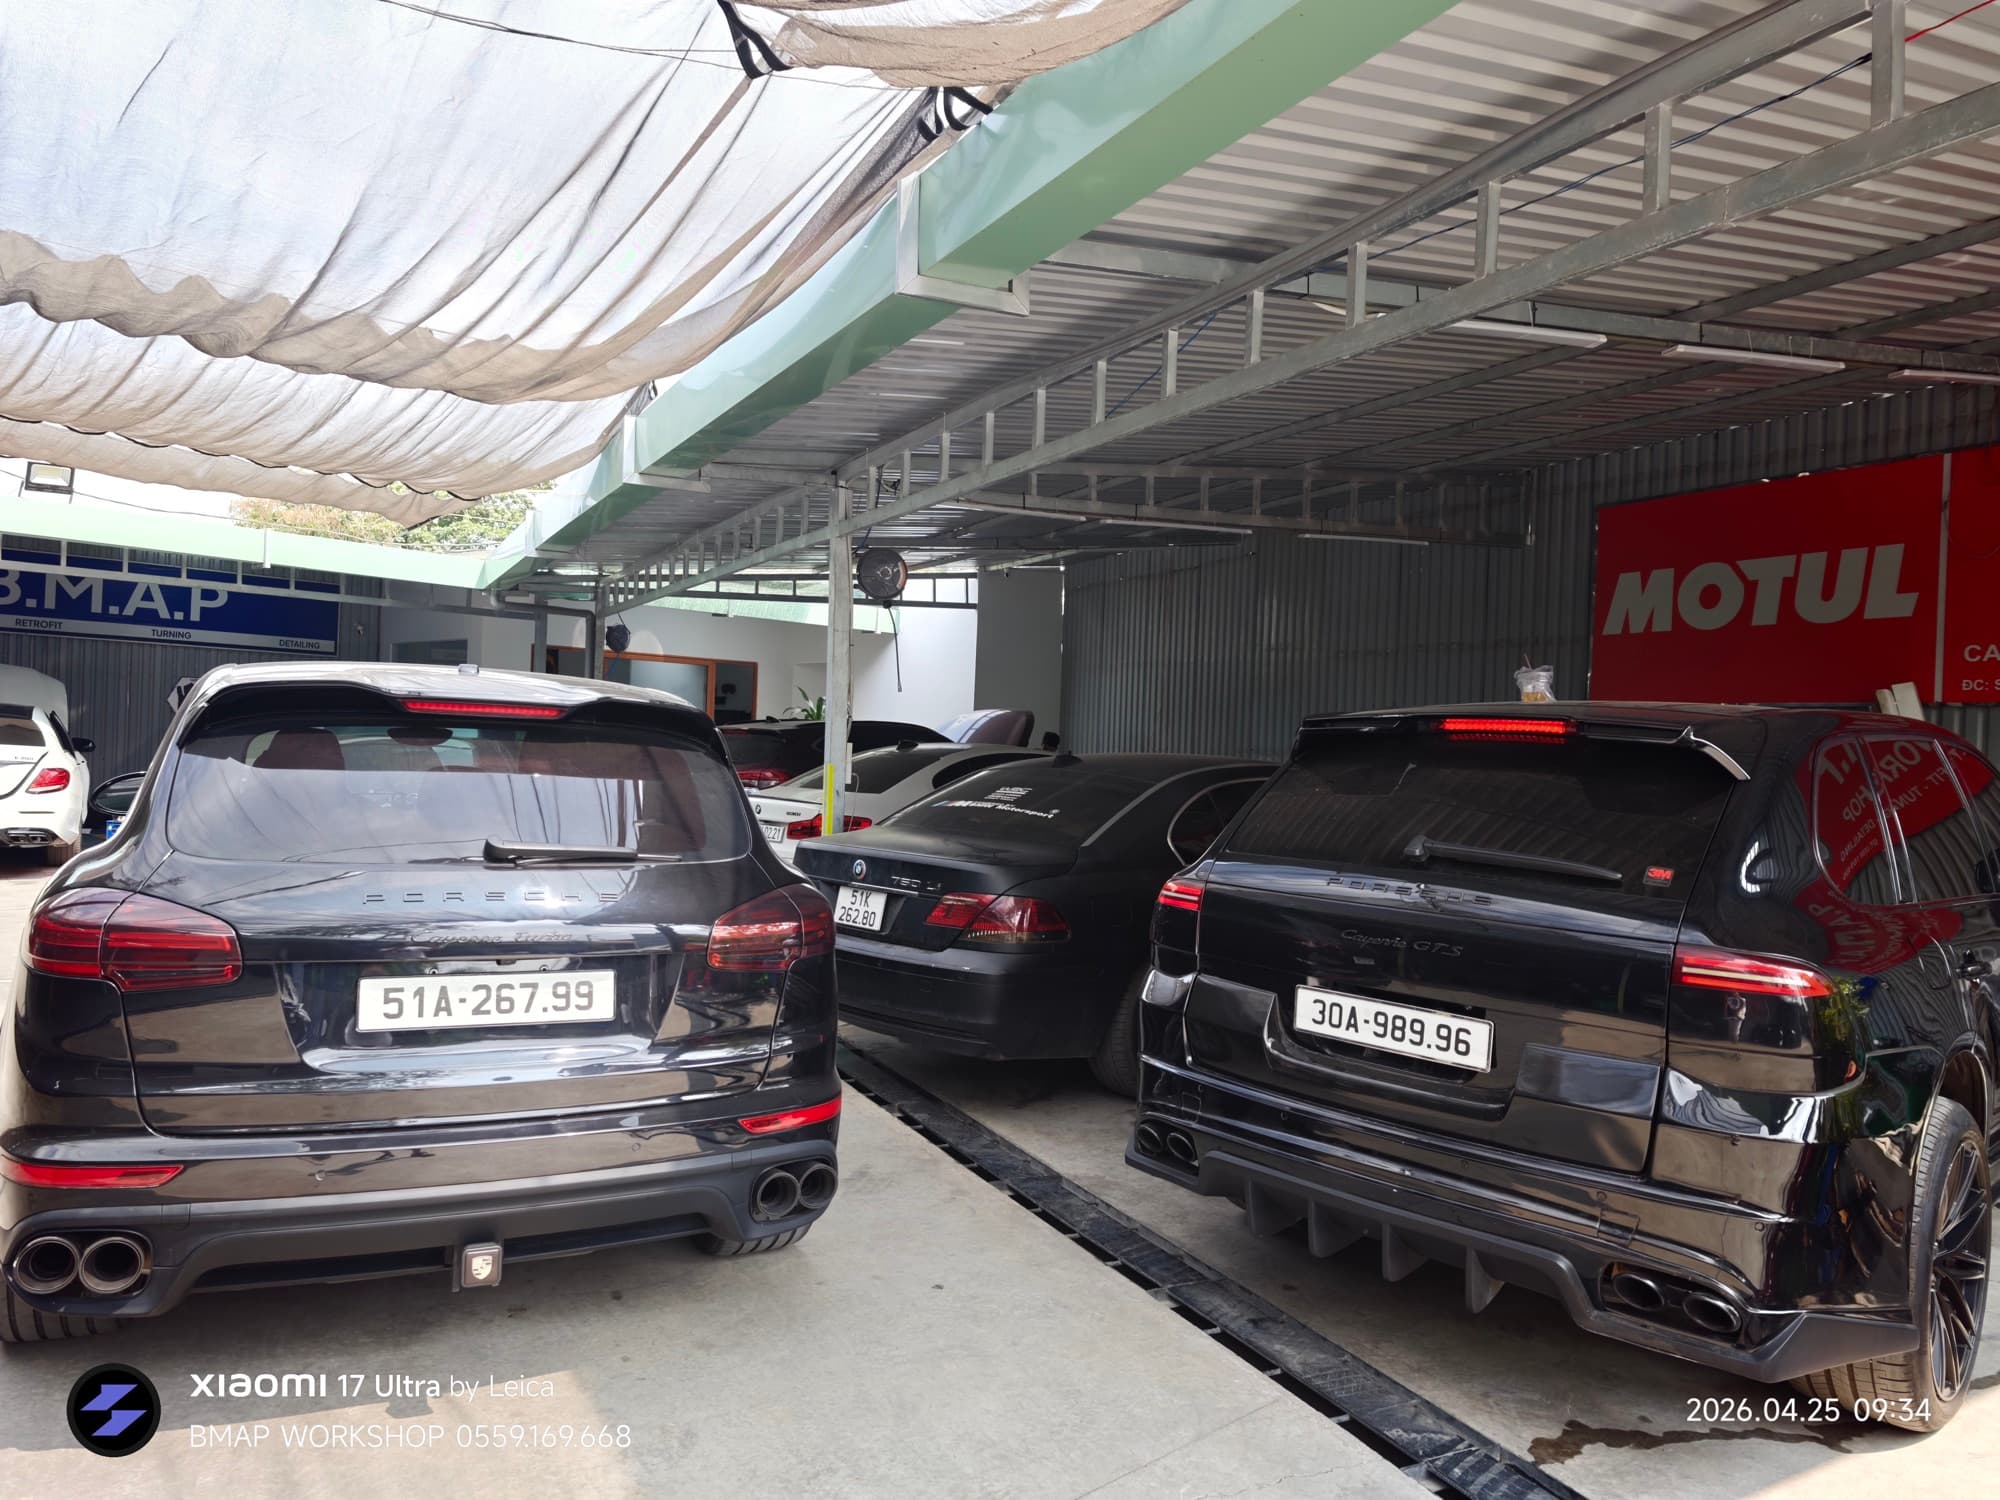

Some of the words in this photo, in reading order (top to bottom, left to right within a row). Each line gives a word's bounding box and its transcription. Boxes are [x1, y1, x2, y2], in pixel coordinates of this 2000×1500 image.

[1602, 544, 1919, 635] MOTUL
[15, 617, 63, 630] RETROFIT
[152, 628, 192, 640] TURNING
[279, 639, 321, 650] DETAILING
[1648, 868, 1671, 880] 3M
[363, 891, 620, 904] PORSCHE
[850, 889, 872, 907] 51K
[838, 906, 876, 927] 262.80
[411, 932, 503, 948] Cayenne
[513, 931, 573, 943] Turbo
[1414, 941, 1464, 957] GTS
[383, 981, 594, 1019] 51A-267.99
[1312, 999, 1472, 1057] 30A-989.96
